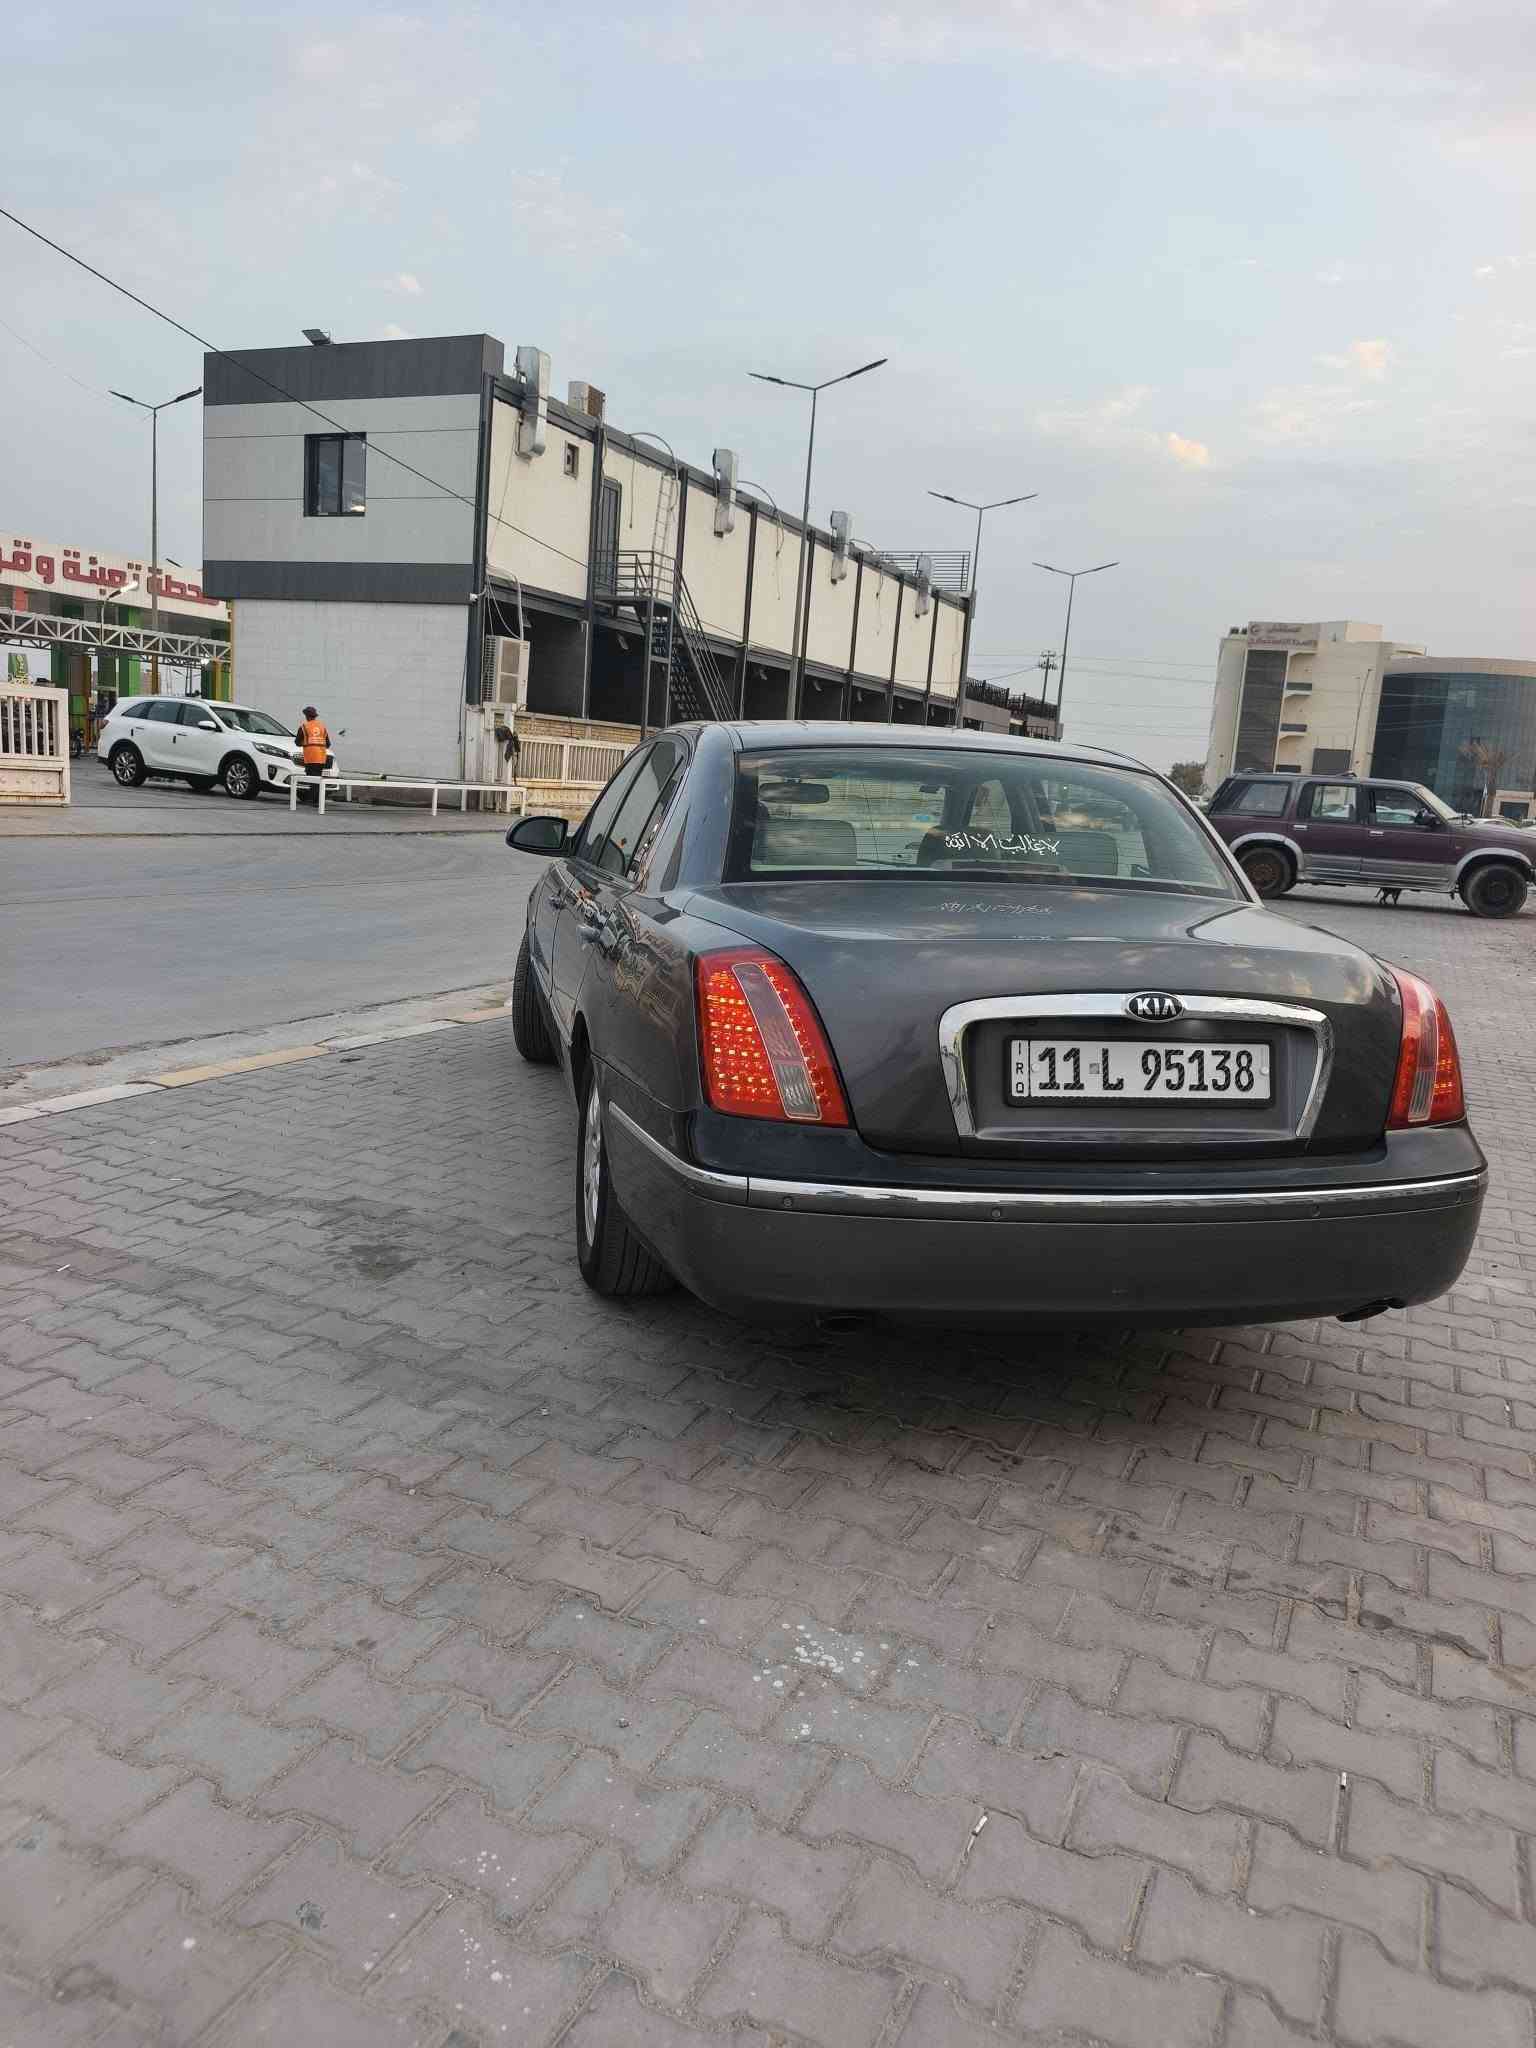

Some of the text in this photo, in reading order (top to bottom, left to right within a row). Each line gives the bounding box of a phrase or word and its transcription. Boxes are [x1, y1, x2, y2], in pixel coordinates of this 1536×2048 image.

[1135, 997, 1177, 1016] KIA
[1038, 1047, 1255, 1093] 11 L 95138
